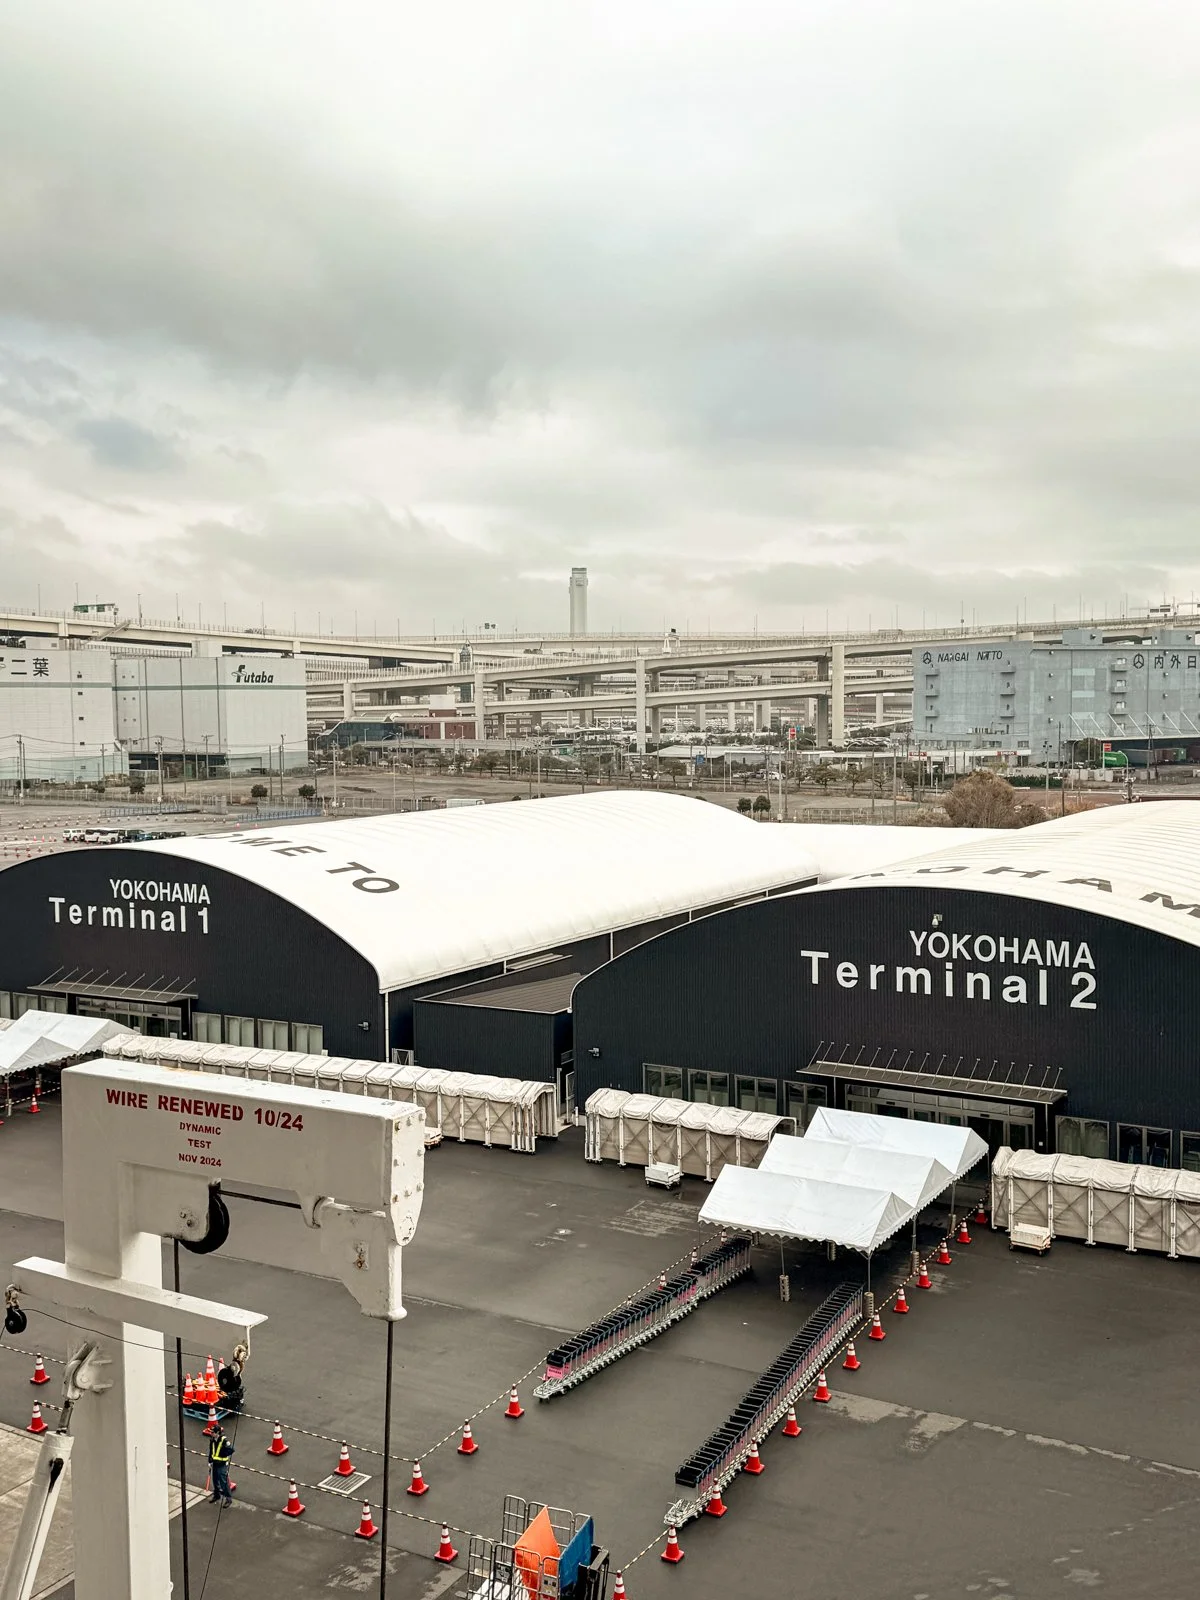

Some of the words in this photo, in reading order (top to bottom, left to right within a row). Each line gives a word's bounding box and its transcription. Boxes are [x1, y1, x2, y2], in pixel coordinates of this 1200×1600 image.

[11, 657, 49, 677] 二葉
[1154, 654, 1197, 669] 内外日
[325, 861, 400, 893] TO
[109, 878, 211, 905] YOKOHAMA
[48, 896, 187, 933] Terminal
[197, 907, 209, 934] 1
[908, 930, 1096, 970] YOKOHAMA
[800, 949, 1048, 1006] Terminal
[1069, 971, 1097, 1010] 2
[106, 1088, 148, 1109] WIRE
[157, 1094, 244, 1121] RENEWED
[254, 1107, 304, 1132] 10/24
[179, 1121, 221, 1136] DYNAMIC
[187, 1138, 212, 1150] TEST
[178, 1152, 198, 1163] NOV
[200, 1155, 222, 1168] 2024
